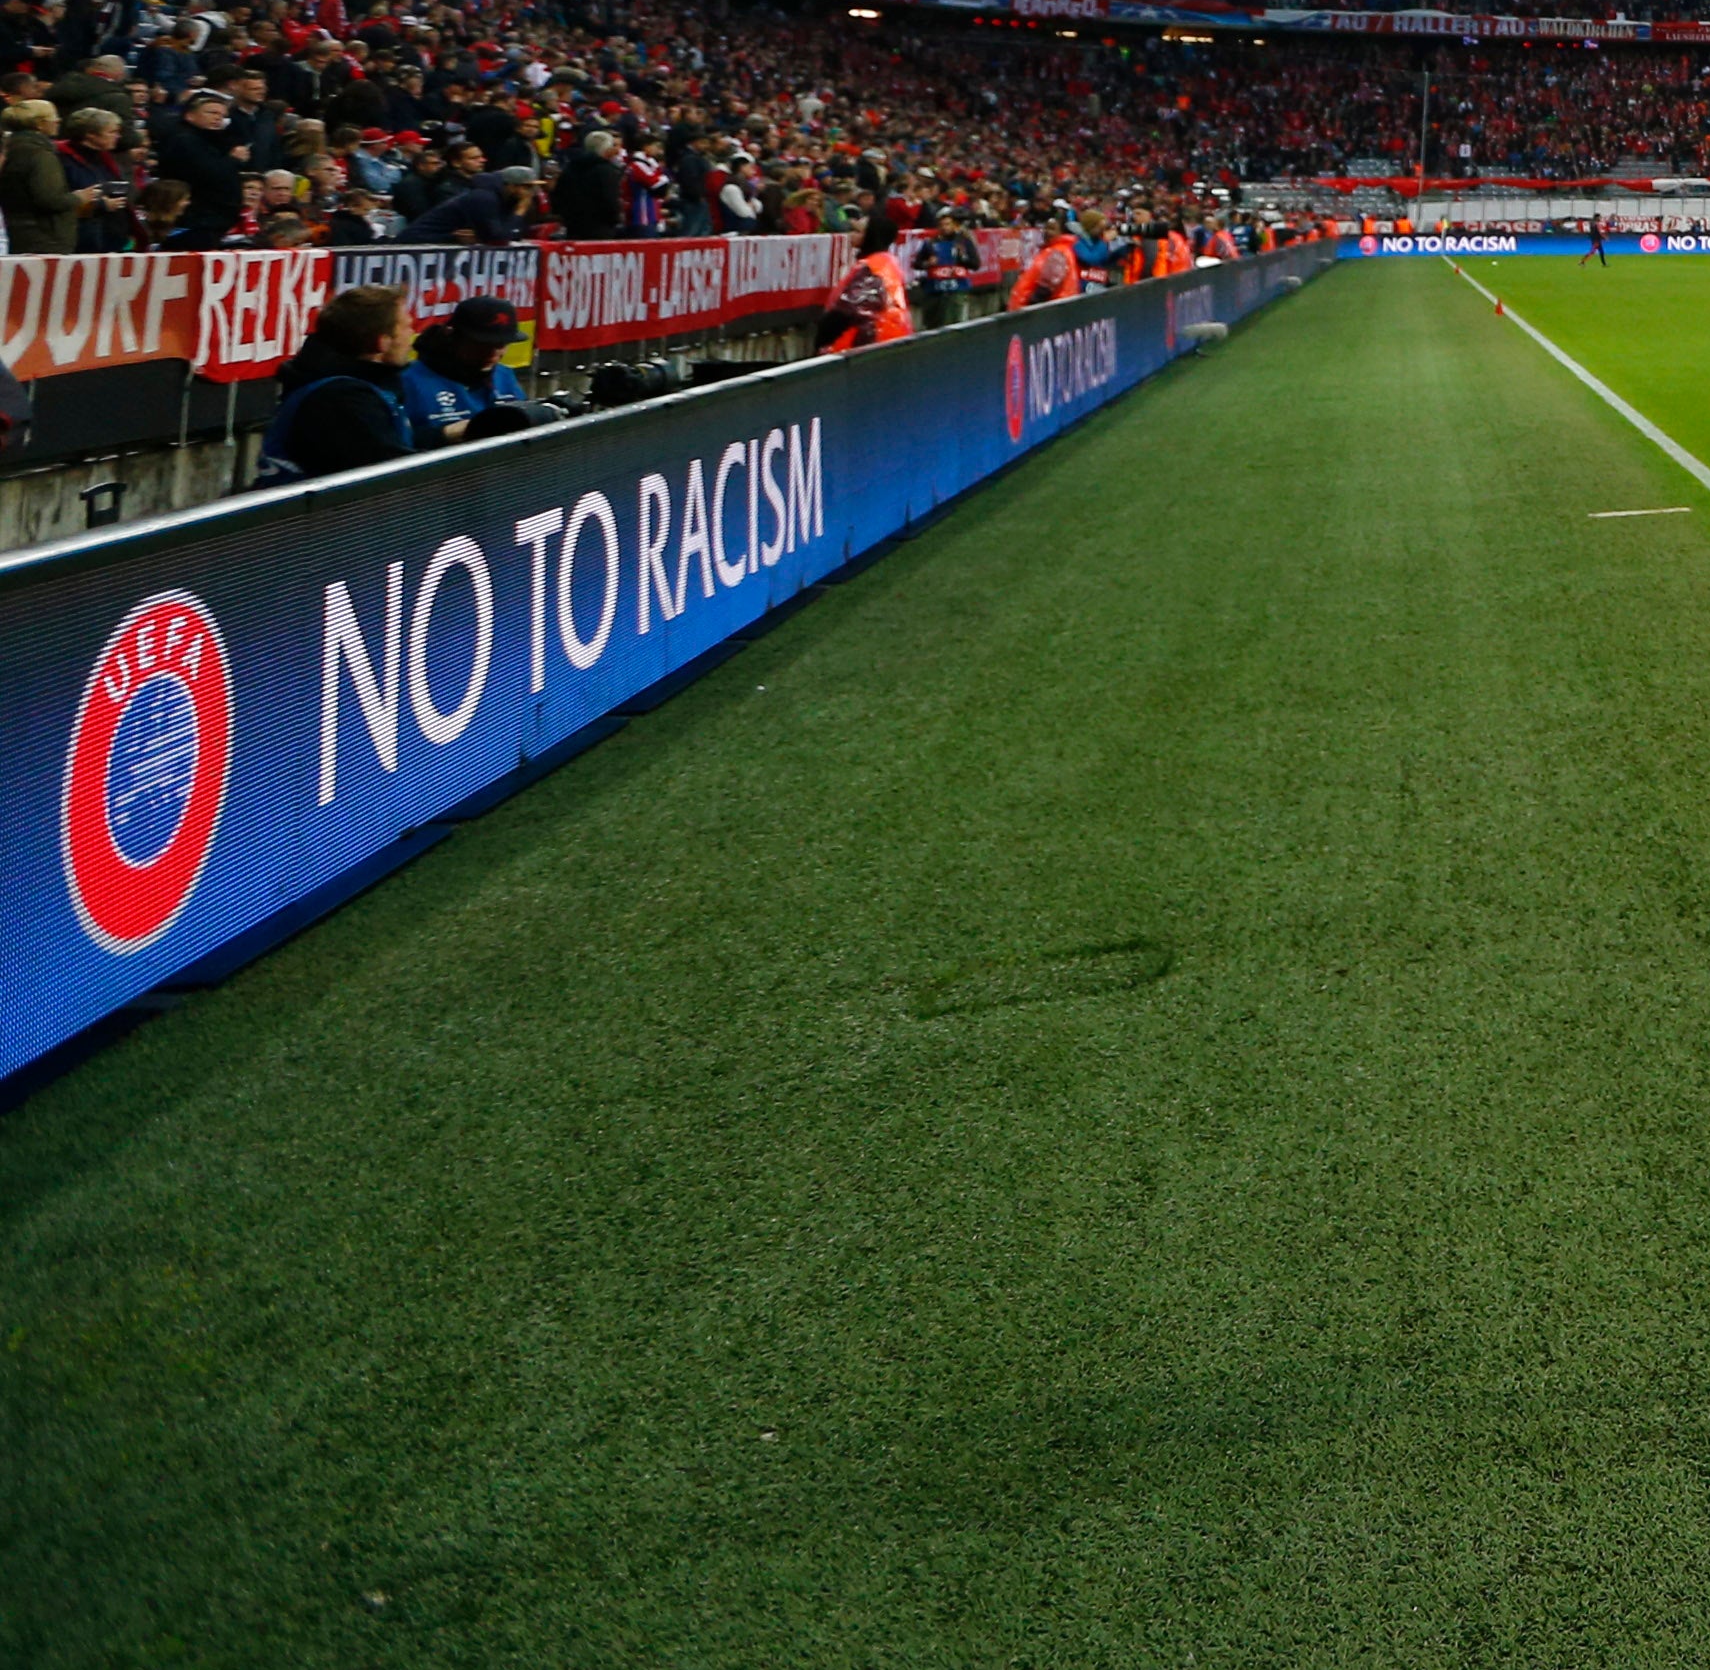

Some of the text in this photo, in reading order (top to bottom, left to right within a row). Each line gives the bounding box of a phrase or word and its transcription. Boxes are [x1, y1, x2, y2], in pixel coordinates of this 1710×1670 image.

[1393, 15, 1526, 37] HALLERTAU
[1382, 236, 1517, 253] NO TO RACISM
[1667, 235, 1697, 251] NO
[1029, 336, 1055, 421] NO
[1055, 331, 1073, 407] TO
[318, 416, 824, 807] NO TO RACISM
[102, 615, 206, 704] UEFA
